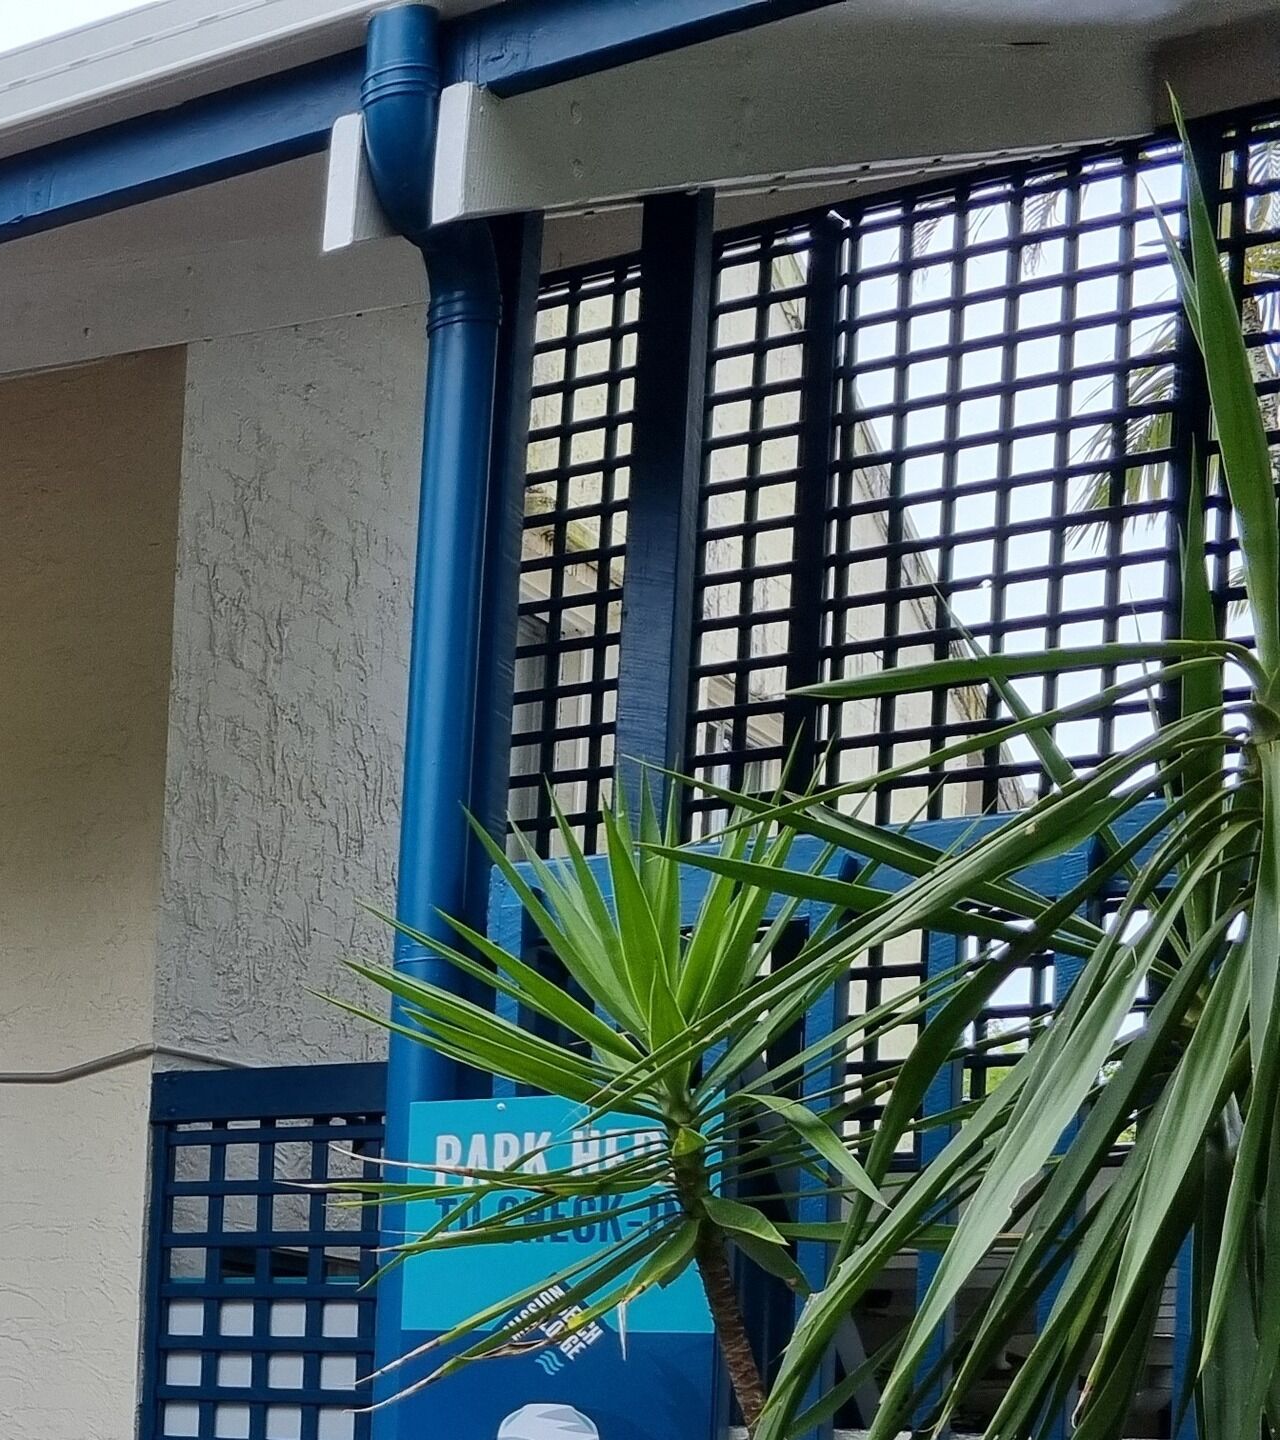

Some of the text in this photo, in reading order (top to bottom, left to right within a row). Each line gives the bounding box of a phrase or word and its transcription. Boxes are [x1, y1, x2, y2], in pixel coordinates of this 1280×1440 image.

[434, 1127, 677, 1187] PARK HE
[538, 1319, 587, 1361] LOGE
